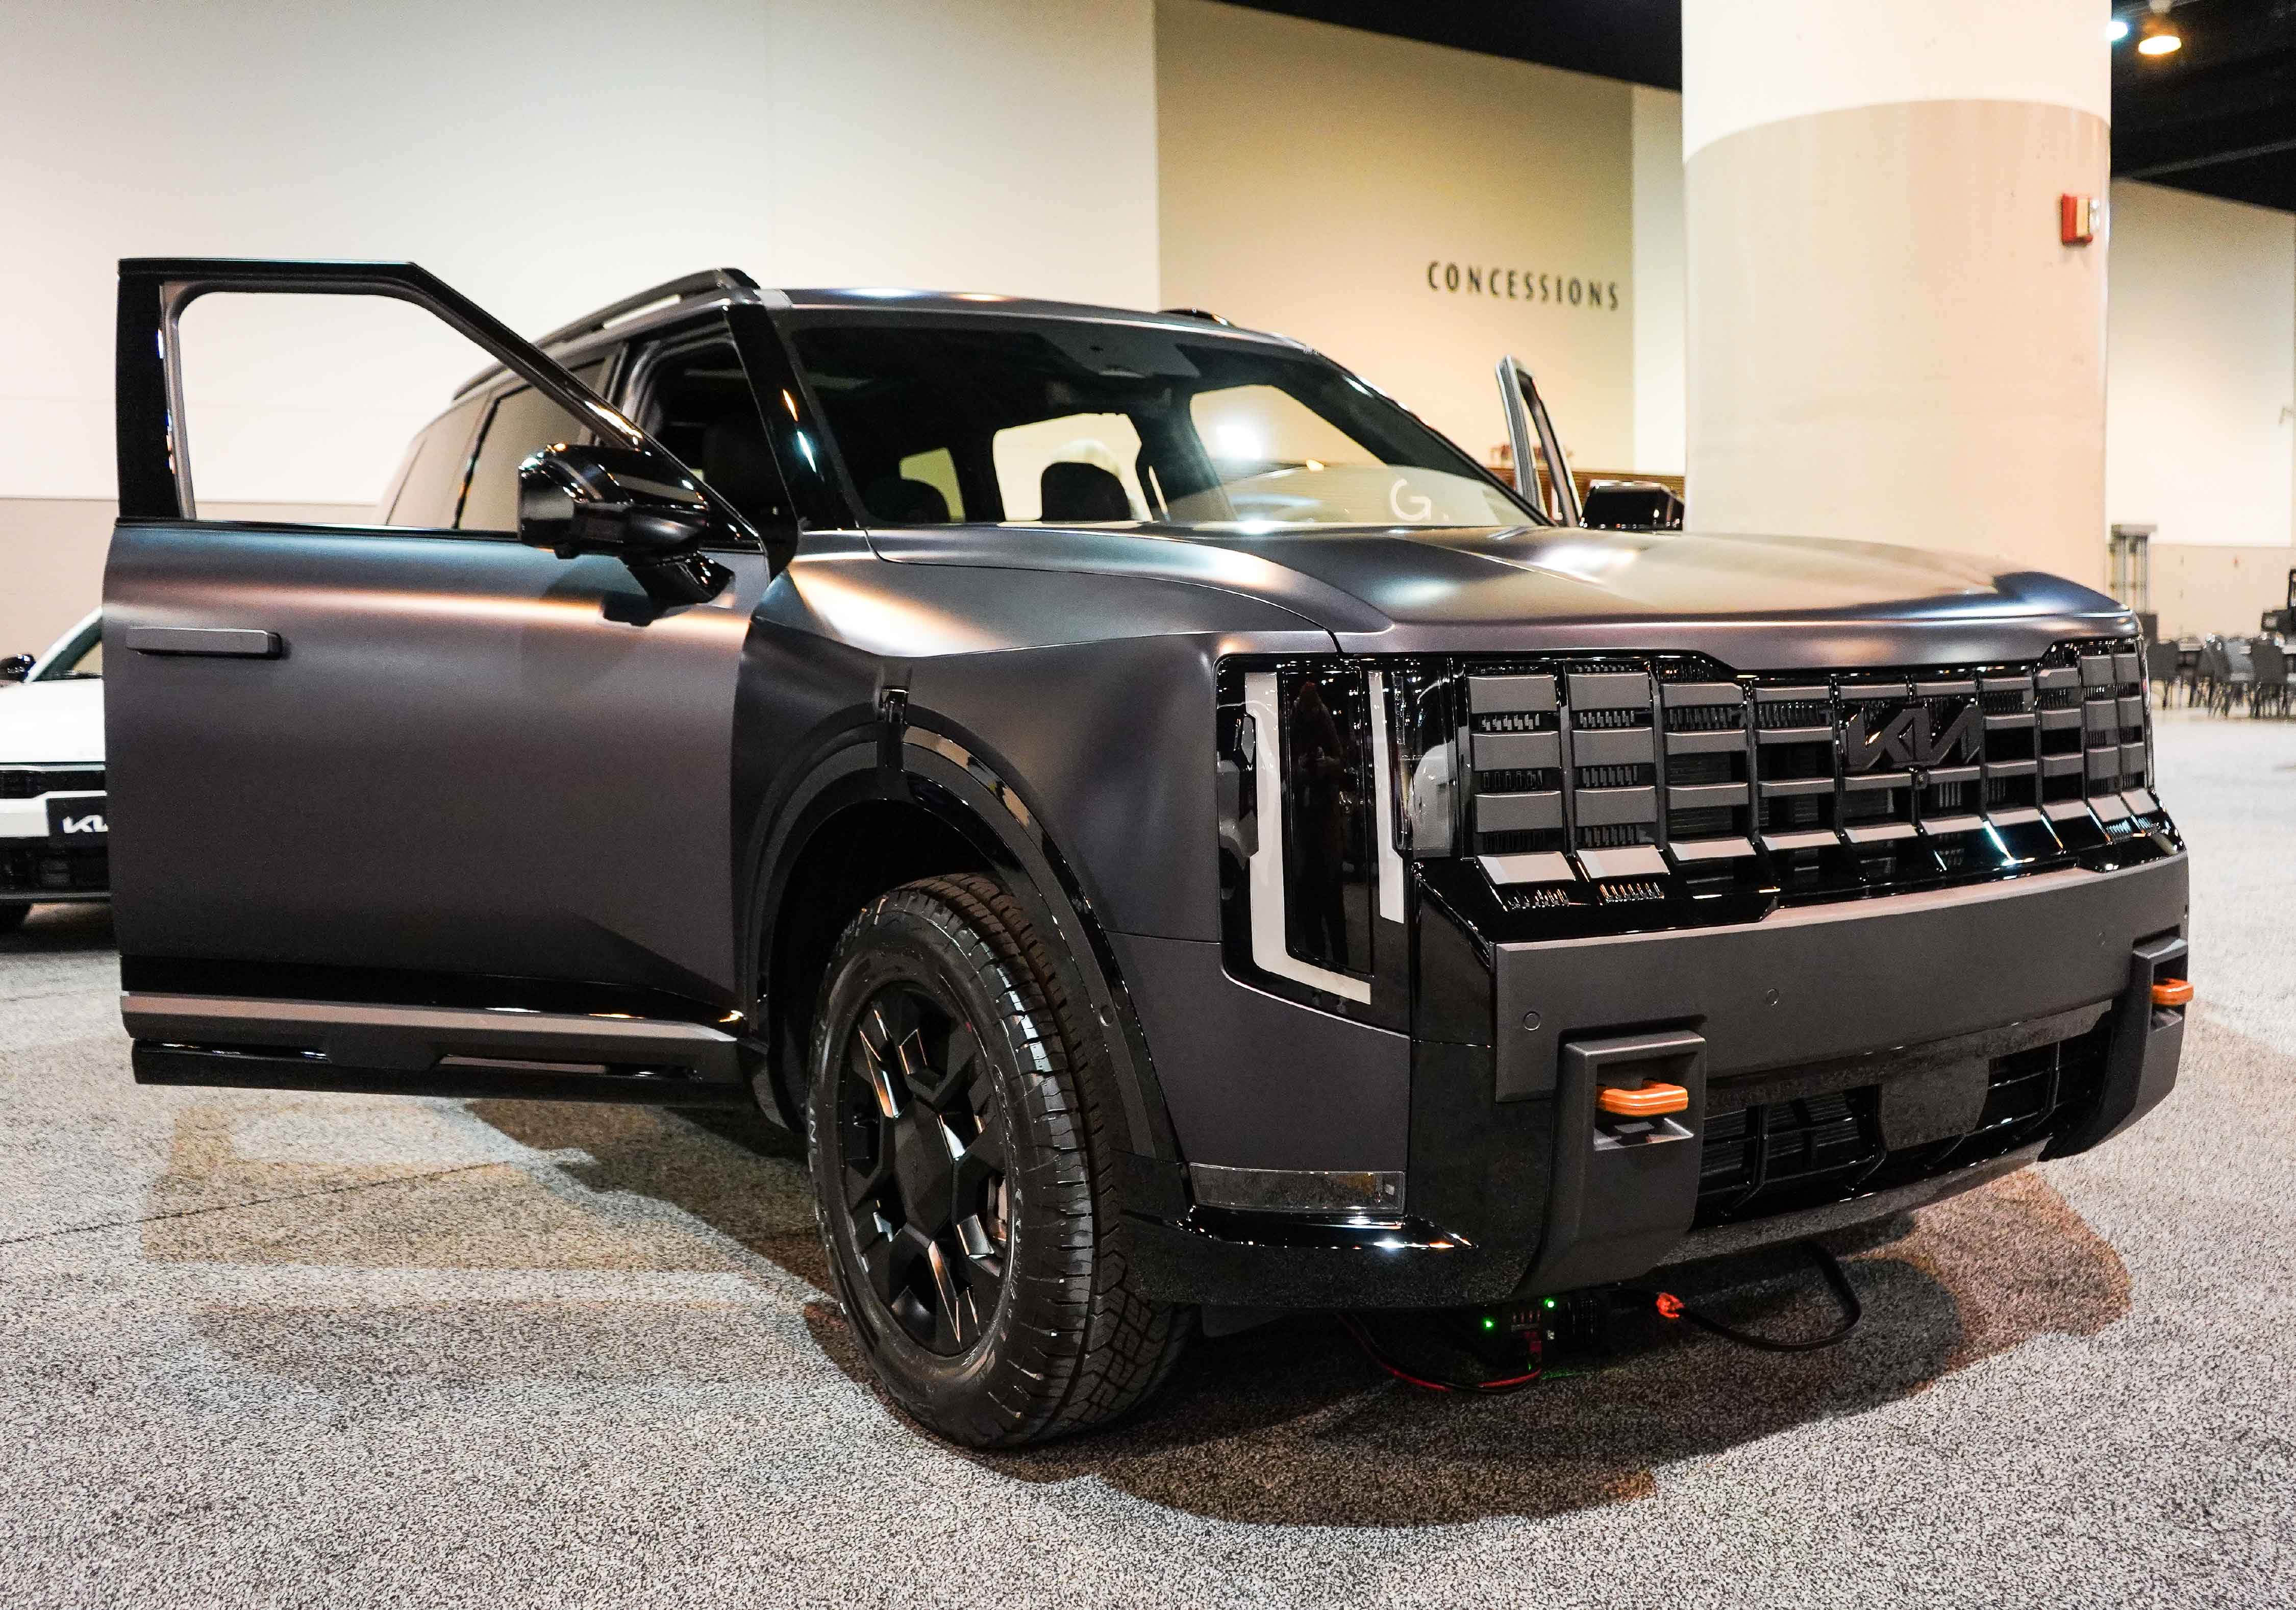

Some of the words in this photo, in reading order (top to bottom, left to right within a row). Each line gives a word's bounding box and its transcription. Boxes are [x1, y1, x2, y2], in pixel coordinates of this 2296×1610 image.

[1427, 260, 1619, 310] CONCESSIONS
[1840, 704, 1984, 771] KIA
[62, 814, 109, 833] KI
